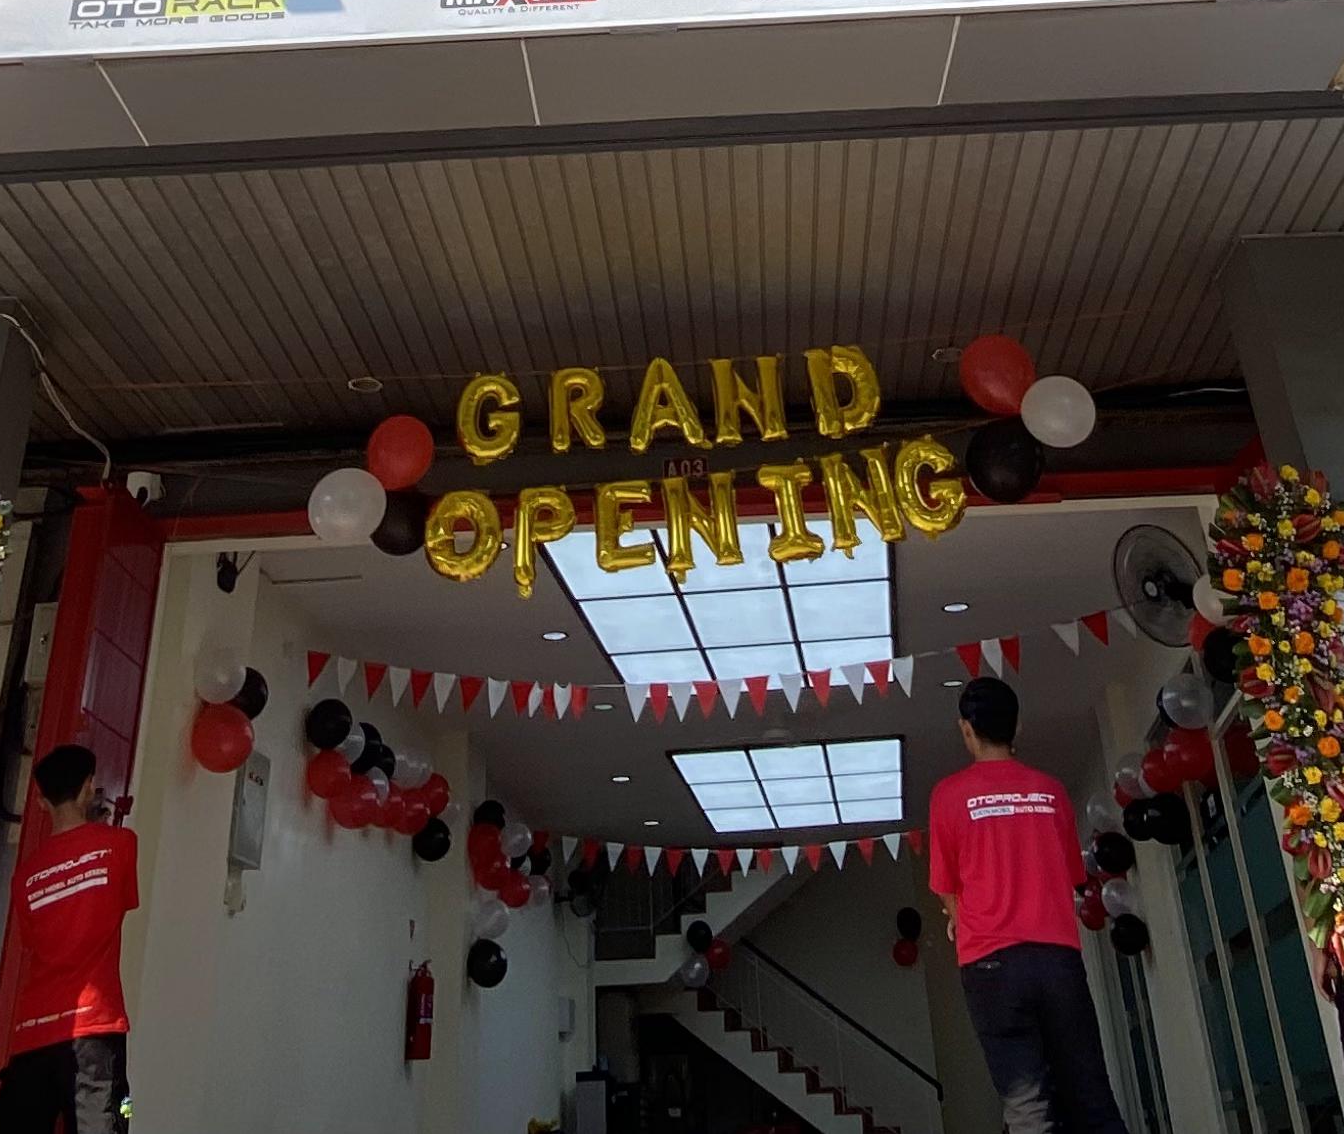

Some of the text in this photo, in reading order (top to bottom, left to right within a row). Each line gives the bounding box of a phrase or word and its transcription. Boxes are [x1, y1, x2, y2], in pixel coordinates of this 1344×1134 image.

[68, 11, 286, 30] TAKE MORE GOODS
[458, 344, 882, 464] GRAND
[424, 434, 967, 599] OPENING
[966, 793, 1055, 808] OTOPROJECT
[25, 849, 109, 888] OTOPROJECT
